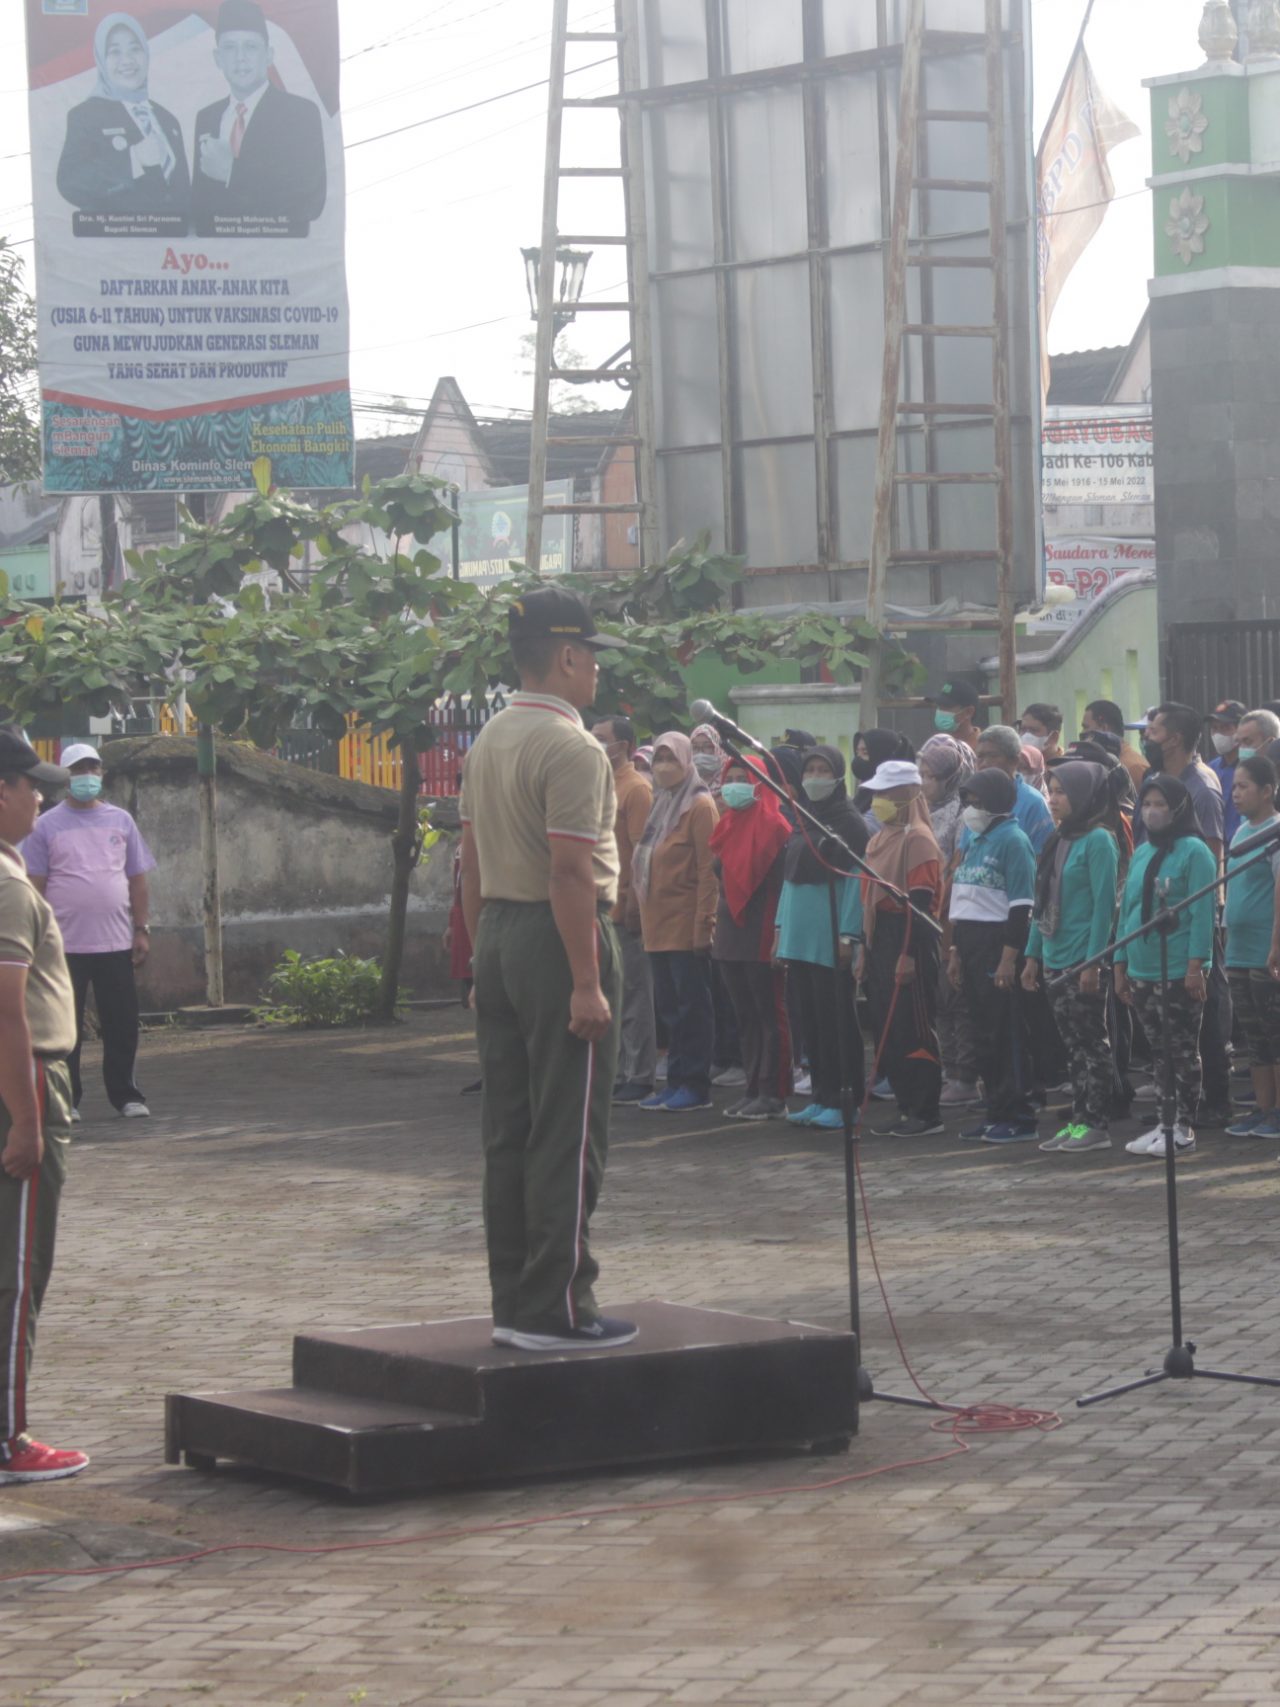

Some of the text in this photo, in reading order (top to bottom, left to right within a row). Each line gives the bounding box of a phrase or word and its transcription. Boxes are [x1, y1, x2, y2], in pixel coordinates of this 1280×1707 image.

[161, 247, 230, 275] Ayo...
[100, 279, 290, 296] DAFTARKAN ANAK-ANAK KITA
[51, 306, 339, 328] (USIA 6-11 TAHUN) UNTUK VAKSINASI COVID-19
[73, 334, 320, 352] GUNA MEWUJUDKAN GENERASI SLEMAN
[107, 361, 289, 380] YANG SEHAT DAN PRODUKTIF
[252, 422, 347, 436] Kesehatan Pulih
[52, 445, 99, 457] Sleman
[251, 440, 350, 455] Ekonomi Bangkit
[132, 459, 255, 472] Dinas Kominfo Slem
[1074, 453, 1124, 469] Ke-106
[1126, 476, 1146, 486] 2022
[1044, 543, 1109, 561] Saudara
